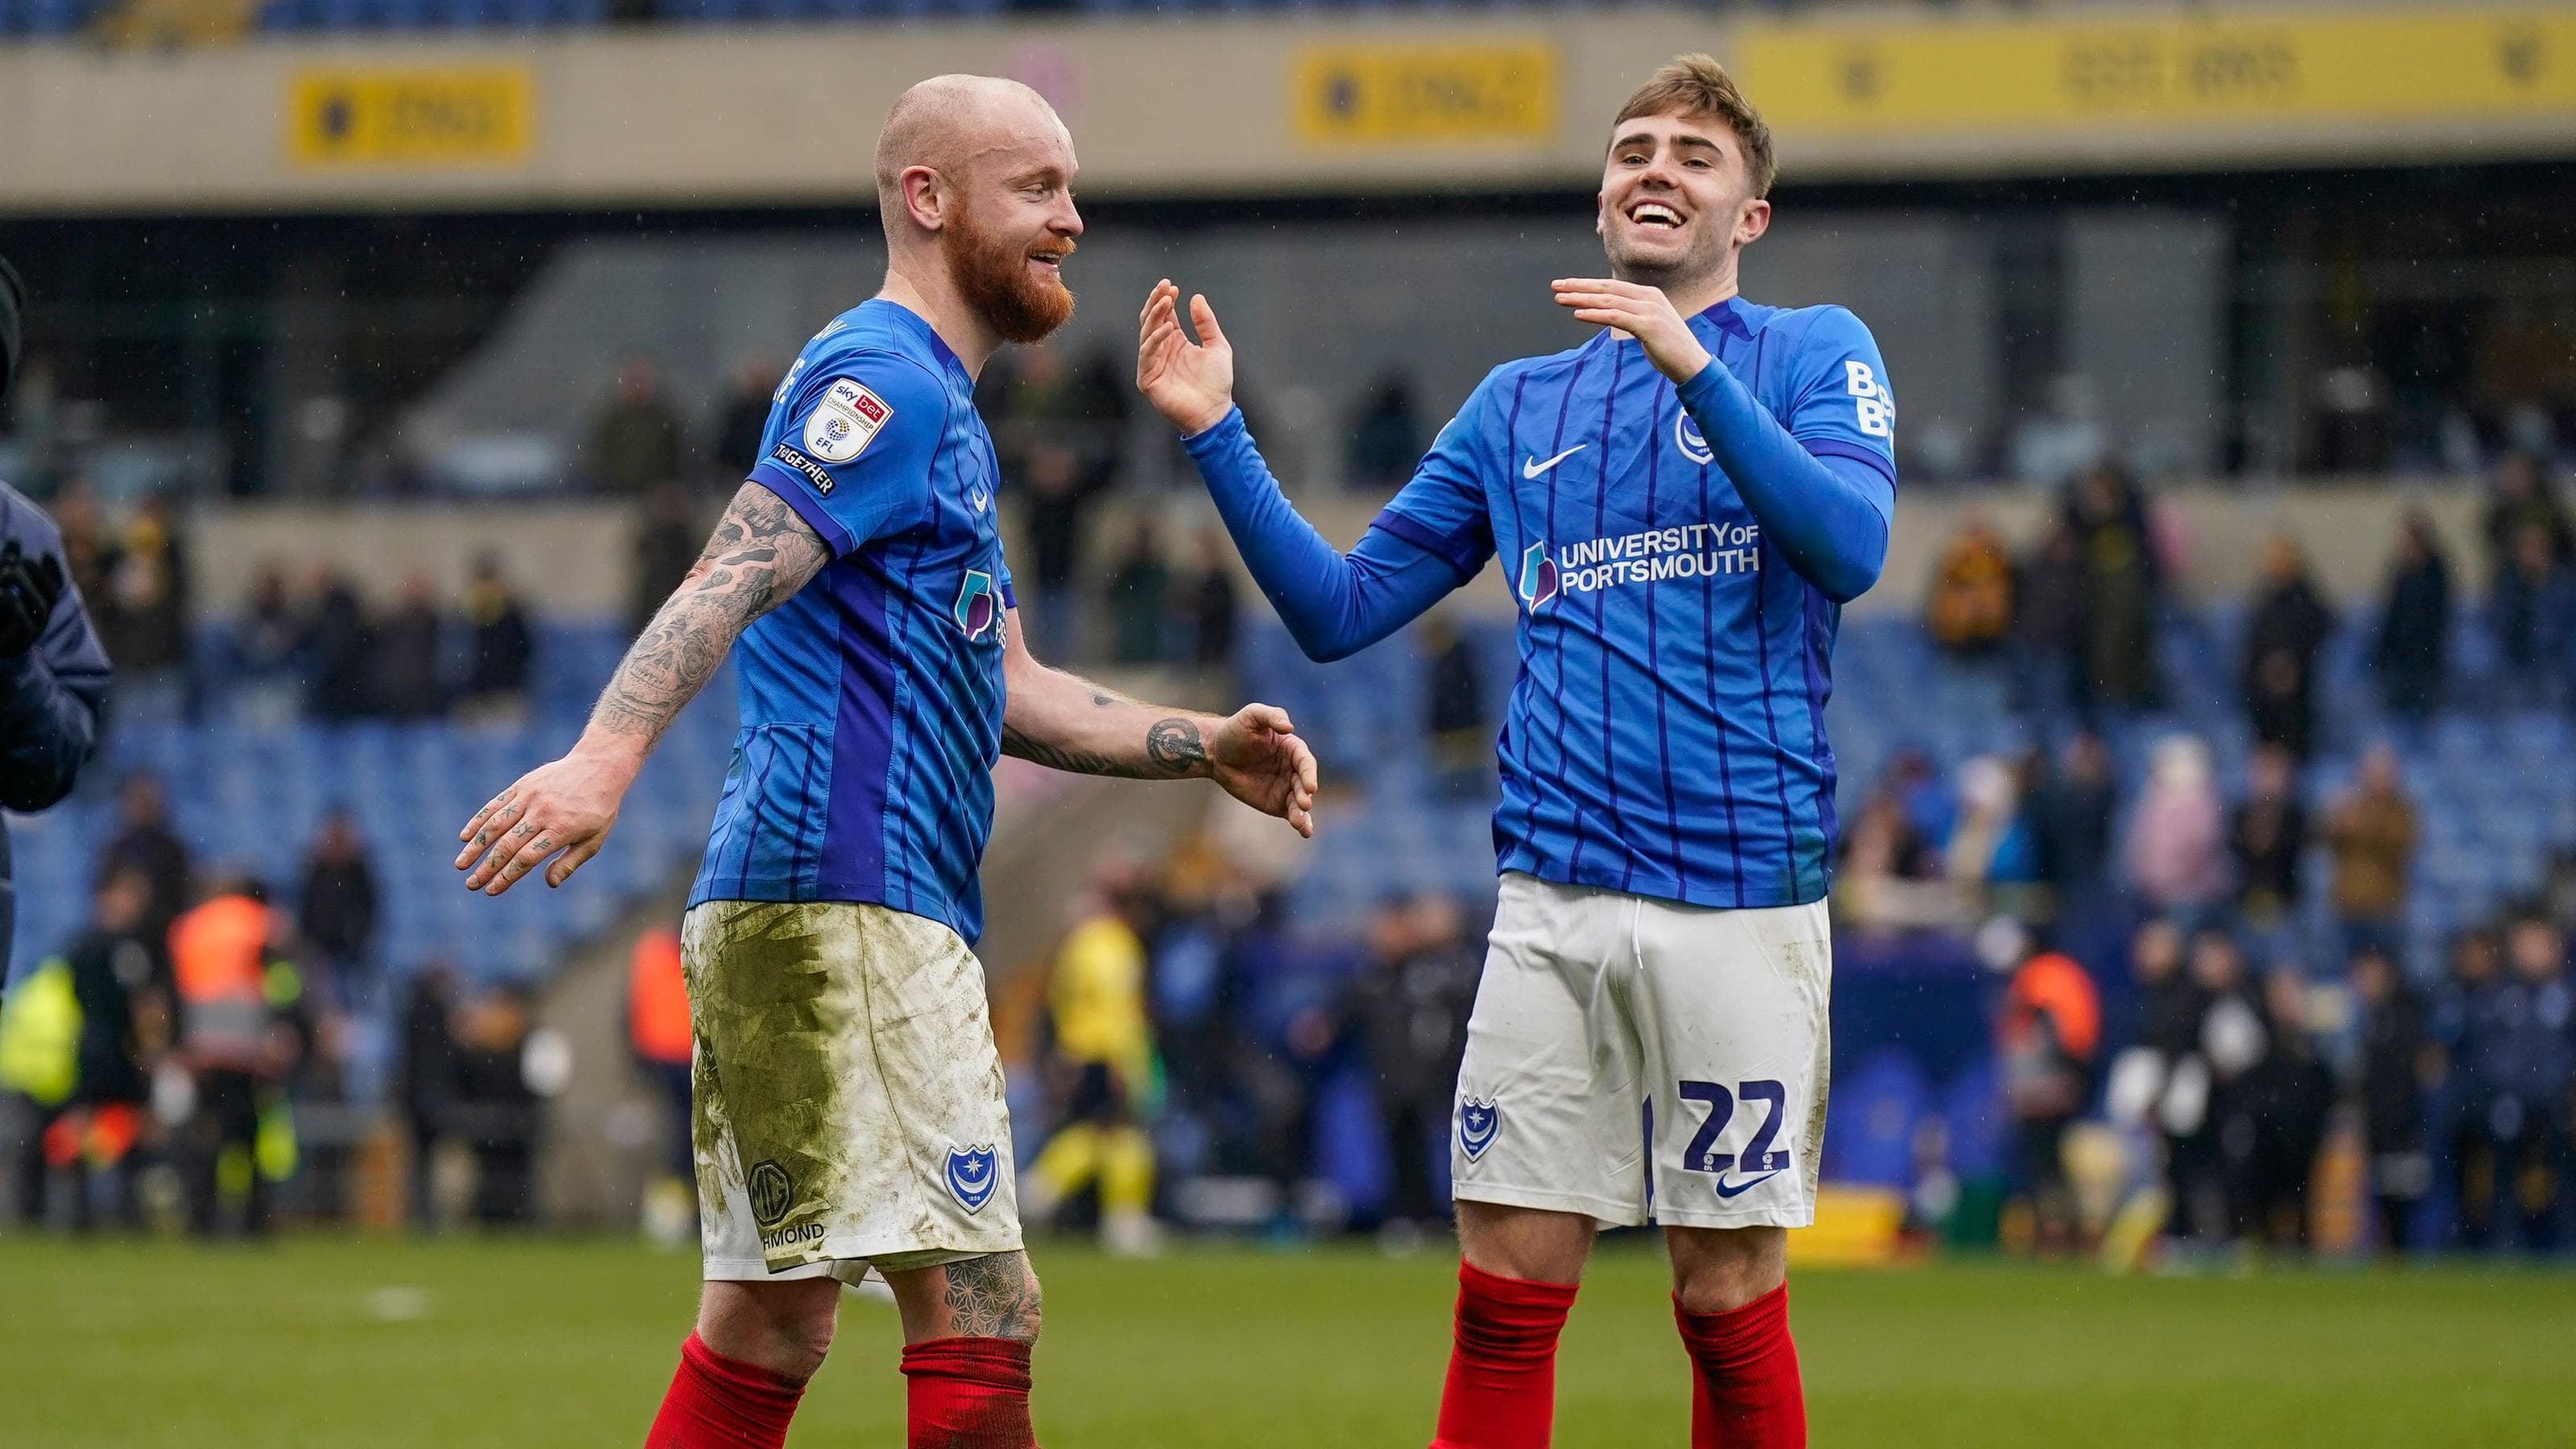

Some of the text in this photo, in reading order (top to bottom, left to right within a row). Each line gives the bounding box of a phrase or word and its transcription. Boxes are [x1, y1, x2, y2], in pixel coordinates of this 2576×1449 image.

[828, 397, 874, 430] CHAMPIONSHIP
[836, 386, 881, 419] sky bet
[774, 444, 834, 494] TOGETHER
[815, 437, 834, 454] EFL
[1561, 522, 1759, 569] UNIVERSITY OF
[1561, 547, 1760, 596] PORTSMOUTH
[1678, 1080, 1790, 1172] 22
[750, 1164, 790, 1222] MG
